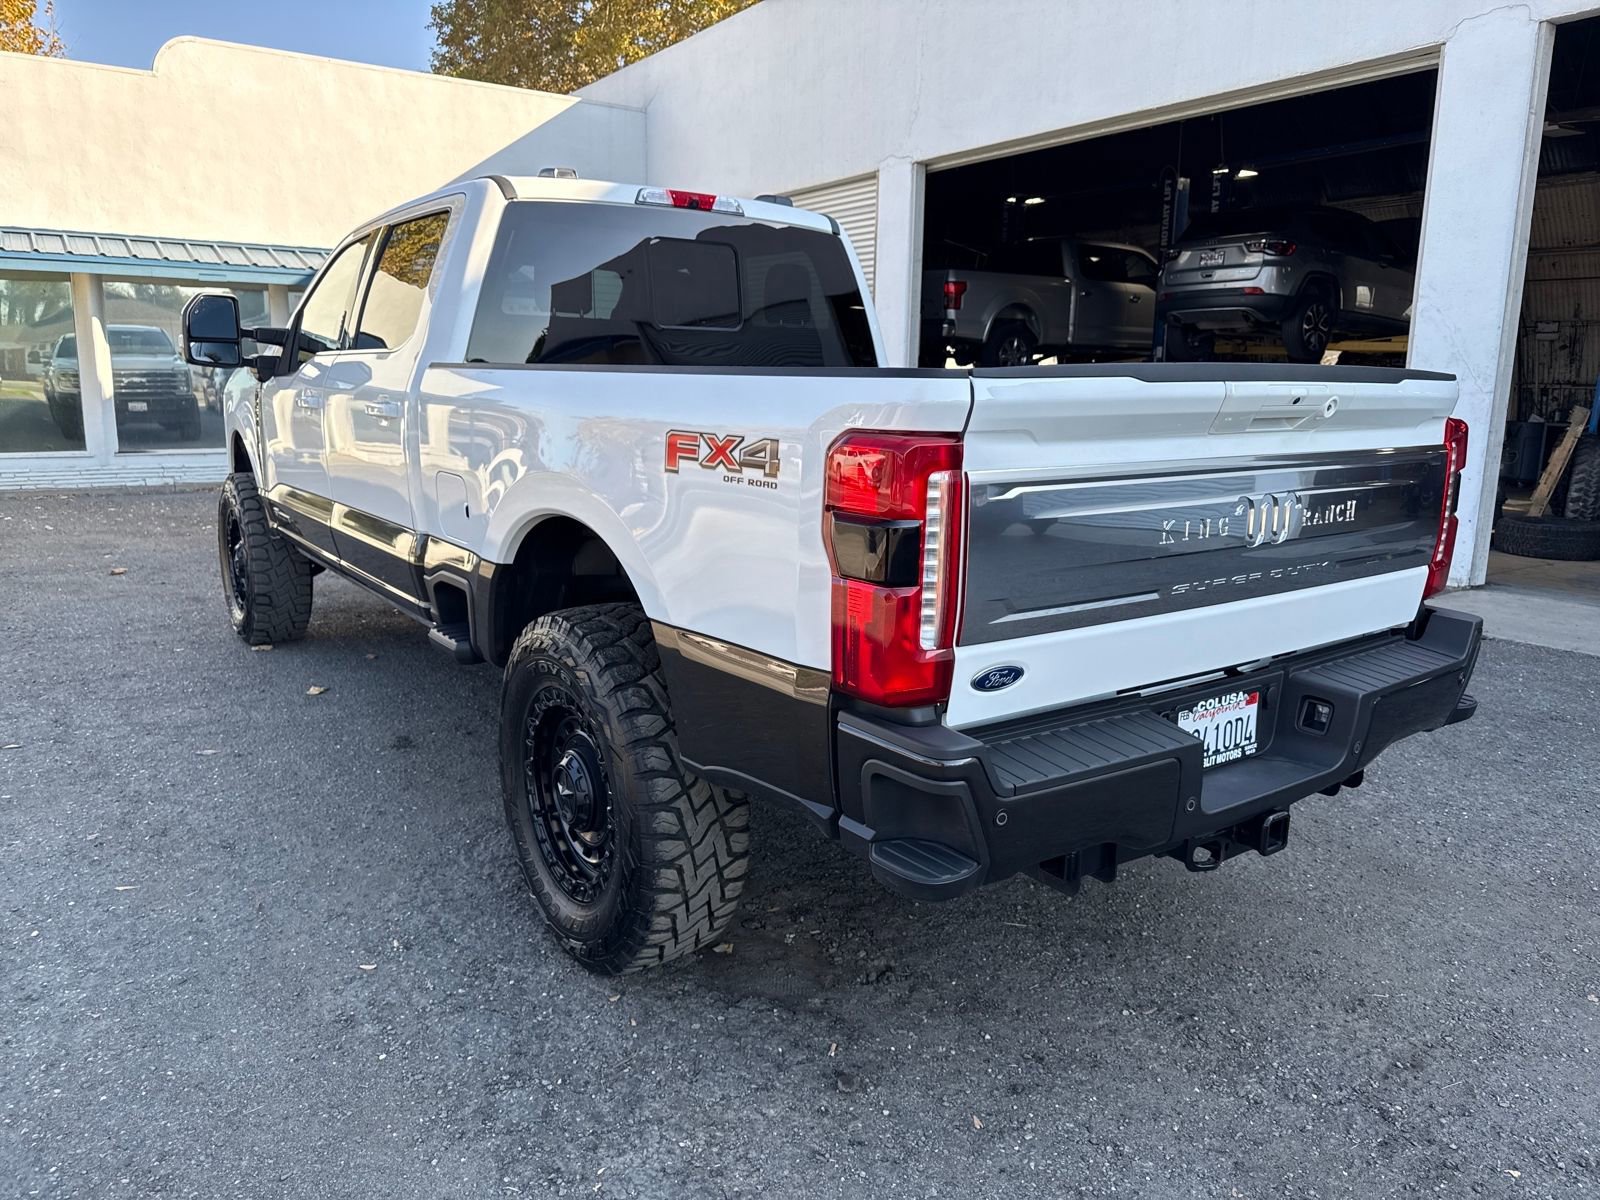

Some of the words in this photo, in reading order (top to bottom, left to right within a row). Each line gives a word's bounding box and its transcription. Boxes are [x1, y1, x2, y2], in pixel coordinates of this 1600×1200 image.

[1164, 180, 1173, 201] LIFT
[664, 429, 780, 478] FX4
[723, 475, 744, 485] OFF
[748, 478, 778, 489] ROAD
[1159, 517, 1230, 545] KING
[1301, 500, 1357, 526] RANCH
[1171, 571, 1263, 595] SUPER
[985, 670, 1015, 688] Ford
[1197, 691, 1244, 711] COLUSA
[1216, 748, 1242, 765] MOTORS
